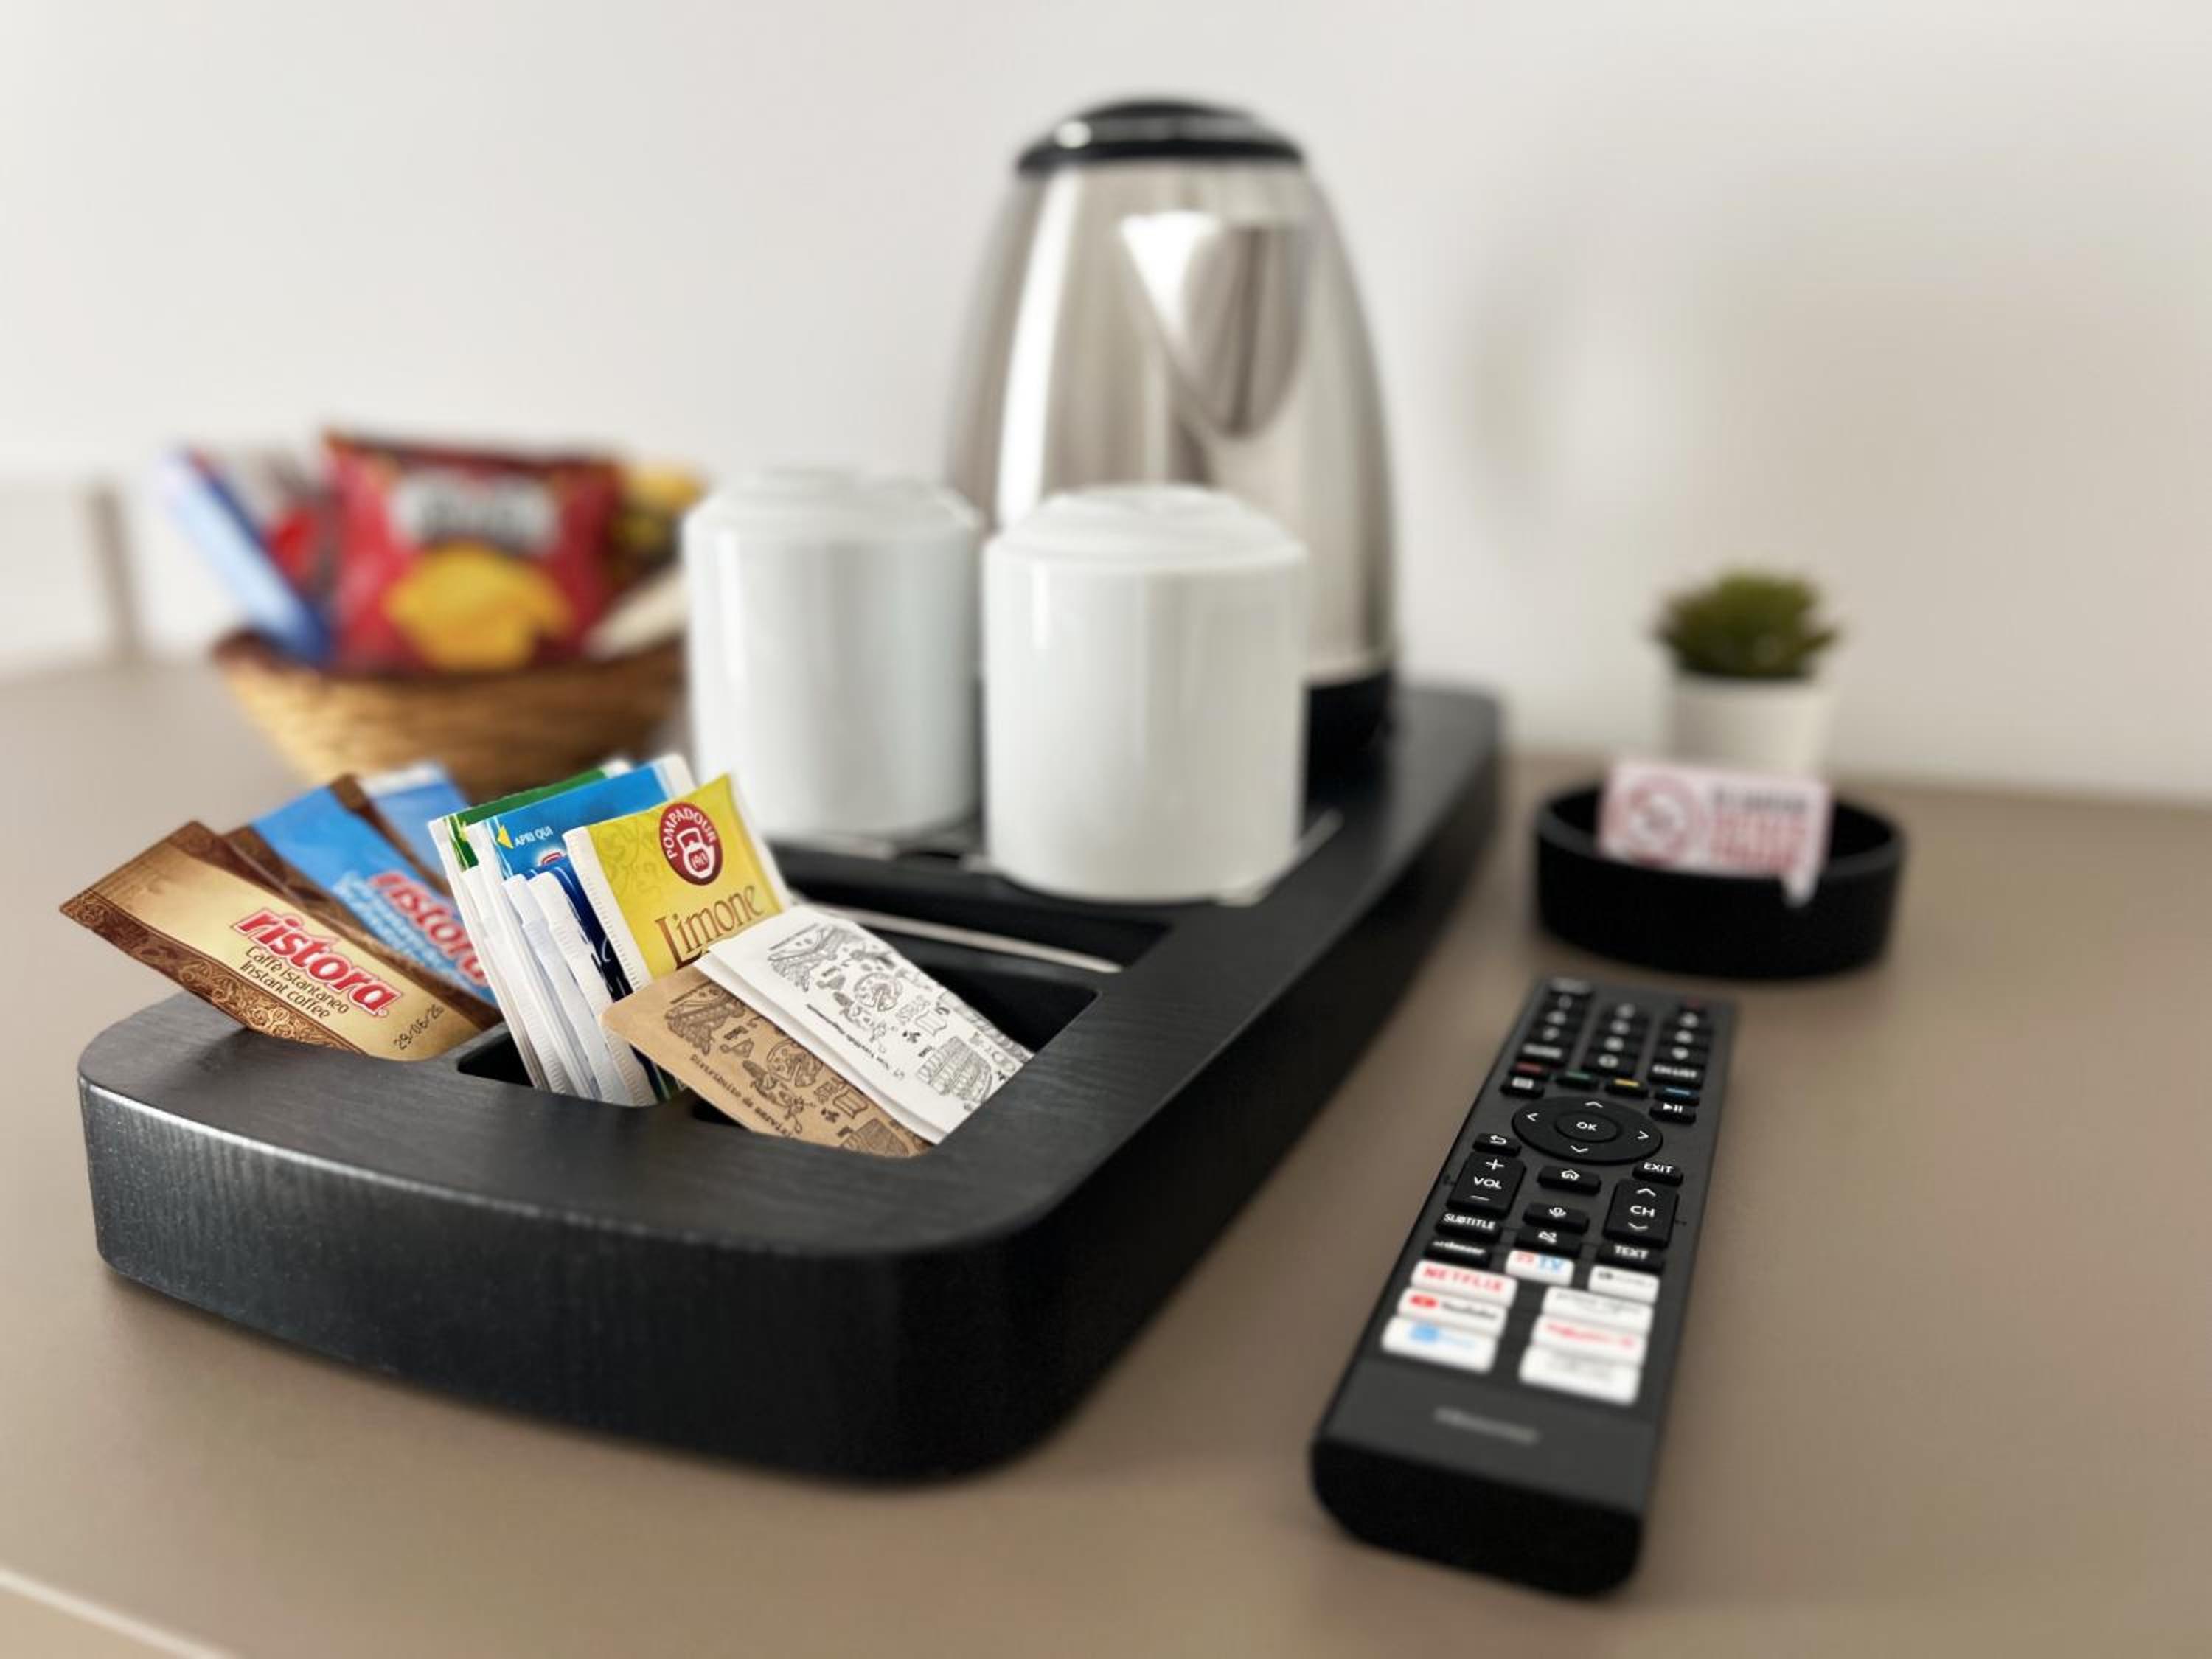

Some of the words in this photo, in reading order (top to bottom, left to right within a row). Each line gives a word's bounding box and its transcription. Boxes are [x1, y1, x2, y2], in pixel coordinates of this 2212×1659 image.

[515, 831, 536, 847] APRI
[535, 825, 554, 841] QUI
[663, 807, 716, 859] POMPADOUR
[655, 884, 764, 970] Limone
[235, 910, 400, 1015] ristora
[240, 959, 289, 994] Instant
[287, 989, 331, 1018] coffee
[246, 945, 282, 972] Caffè
[279, 967, 350, 1015] istantaneo
[1576, 1121, 1598, 1132] OK
[1644, 1161, 1674, 1175] EXIT
[1474, 1176, 1503, 1190] VOL
[1630, 1205, 1655, 1217] CH
[1442, 1213, 1497, 1231] SUBTITLE
[1614, 1245, 1649, 1260] TEXT
